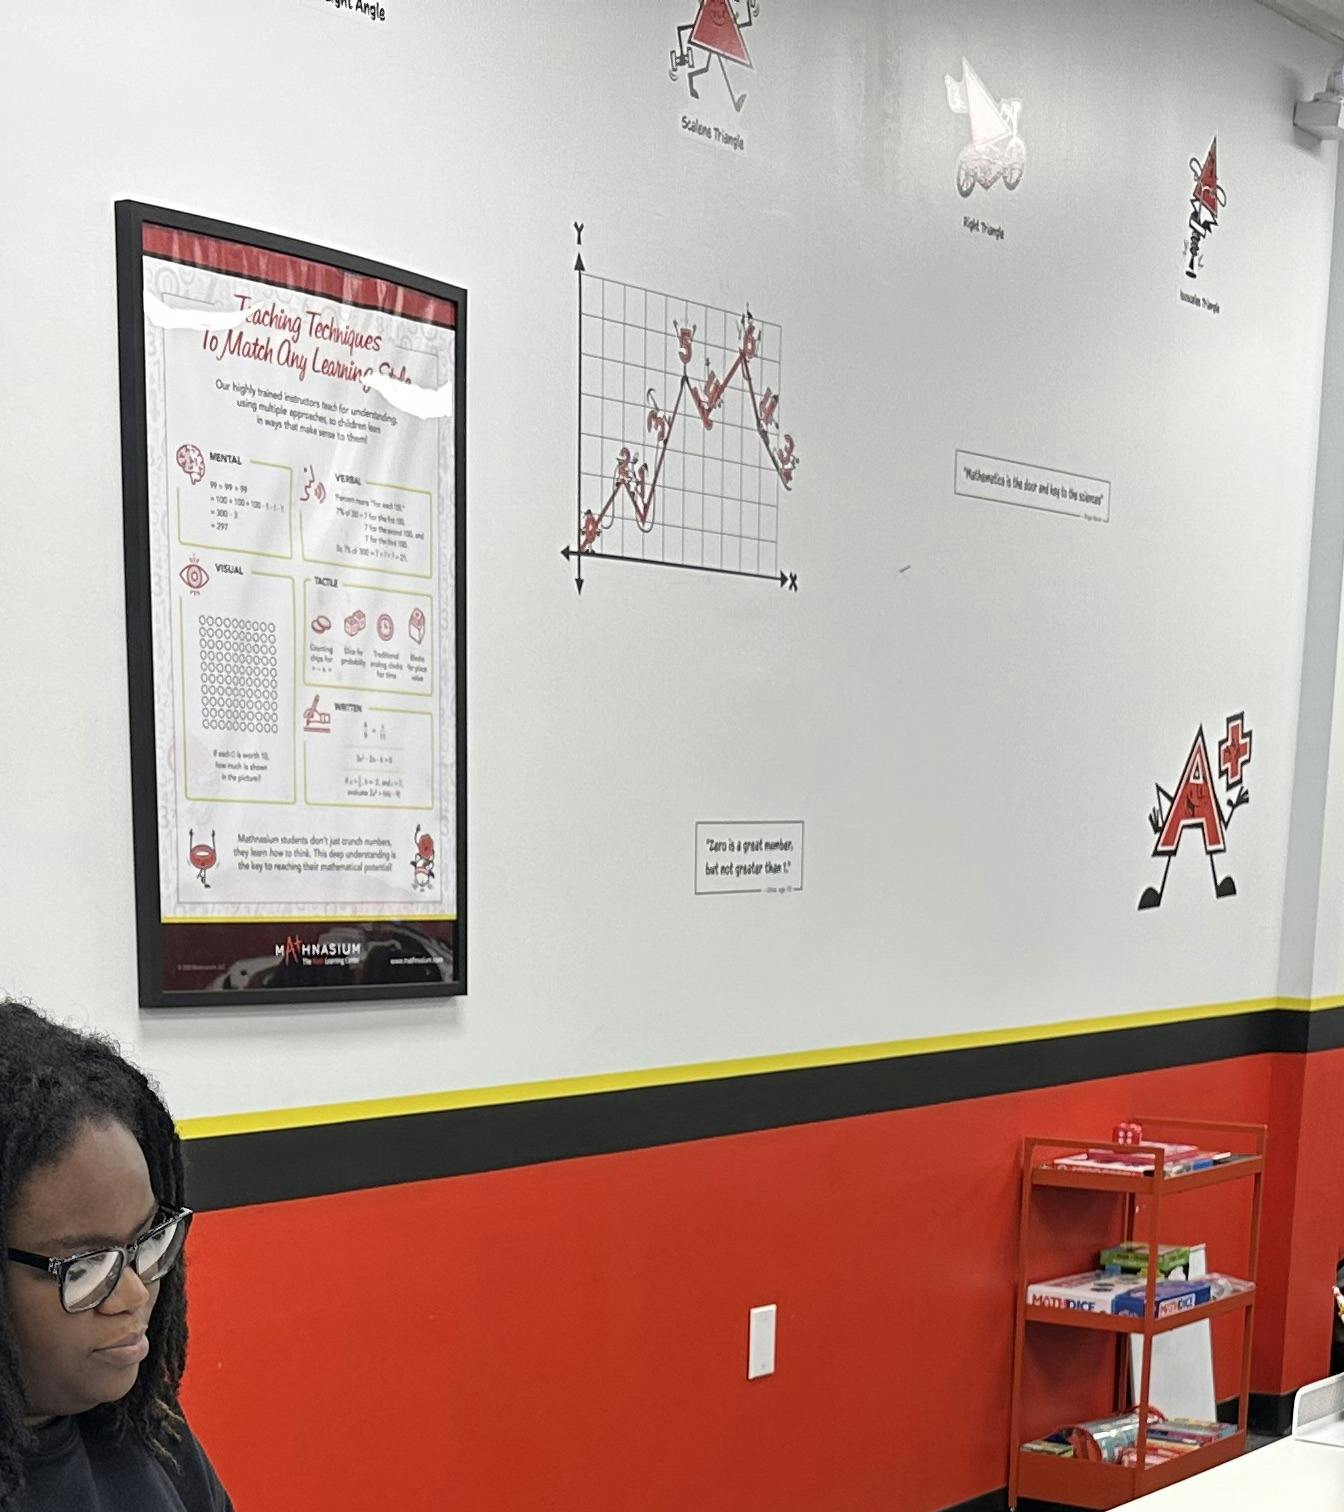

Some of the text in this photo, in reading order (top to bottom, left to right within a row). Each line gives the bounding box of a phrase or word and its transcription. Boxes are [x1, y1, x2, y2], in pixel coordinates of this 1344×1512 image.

[356, 0, 385, 21] Angle
[713, 127, 744, 150] Triangle
[573, 221, 585, 245] Y
[306, 311, 382, 356] Techniques
[216, 329, 274, 364] Match
[276, 340, 308, 381] Any
[215, 378, 231, 391] Our
[233, 381, 256, 397] highly
[257, 387, 283, 401] trained
[284, 392, 320, 409] instructors
[338, 403, 349, 414] for
[236, 399, 257, 412] using
[258, 403, 287, 417] multiple
[338, 417, 367, 431] children
[264, 418, 283, 431] ways
[284, 419, 298, 432] that
[299, 423, 317, 436] make
[337, 430, 345, 441] to
[209, 451, 242, 465] MENTAL
[1012, 475, 1022, 490] the
[1038, 482, 1049, 495] and
[215, 563, 244, 576] VISUAL
[788, 572, 798, 592] X
[238, 834, 279, 844] Mathnasium
[281, 836, 308, 845] students
[728, 838, 735, 852] is
[736, 840, 741, 852] a
[742, 838, 763, 854] great
[234, 848, 249, 858] they
[269, 848, 283, 857] how
[313, 849, 327, 858] This
[346, 849, 389, 860] understanding
[238, 862, 249, 871] the
[251, 862, 263, 872] key
[265, 862, 272, 871] to
[705, 861, 718, 875] but
[720, 862, 734, 875] not
[735, 861, 763, 877] greater
[765, 860, 782, 874] than
